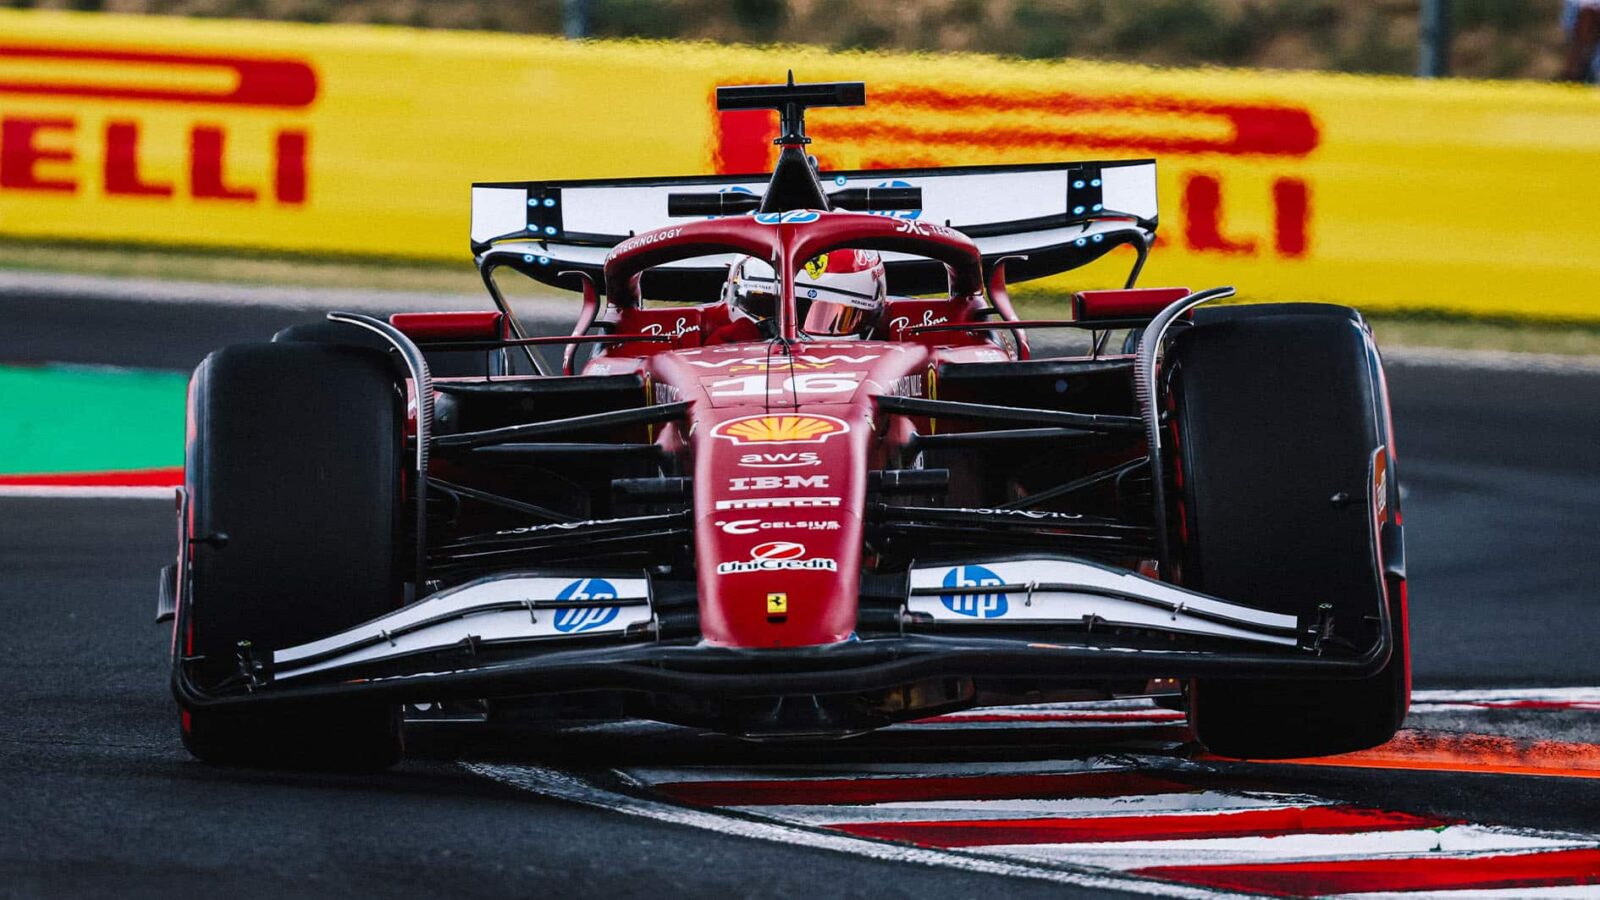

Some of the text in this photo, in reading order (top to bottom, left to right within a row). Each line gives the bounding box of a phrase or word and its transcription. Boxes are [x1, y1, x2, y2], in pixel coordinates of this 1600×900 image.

[889, 309, 948, 333] R-Ban
[711, 372, 860, 397] 16
[739, 452, 822, 465] aws
[728, 475, 830, 492] IBM
[715, 496, 842, 511] PIRELLI
[719, 559, 838, 573] UniCredit
[944, 565, 1006, 618] hp
[555, 578, 618, 633] hp
